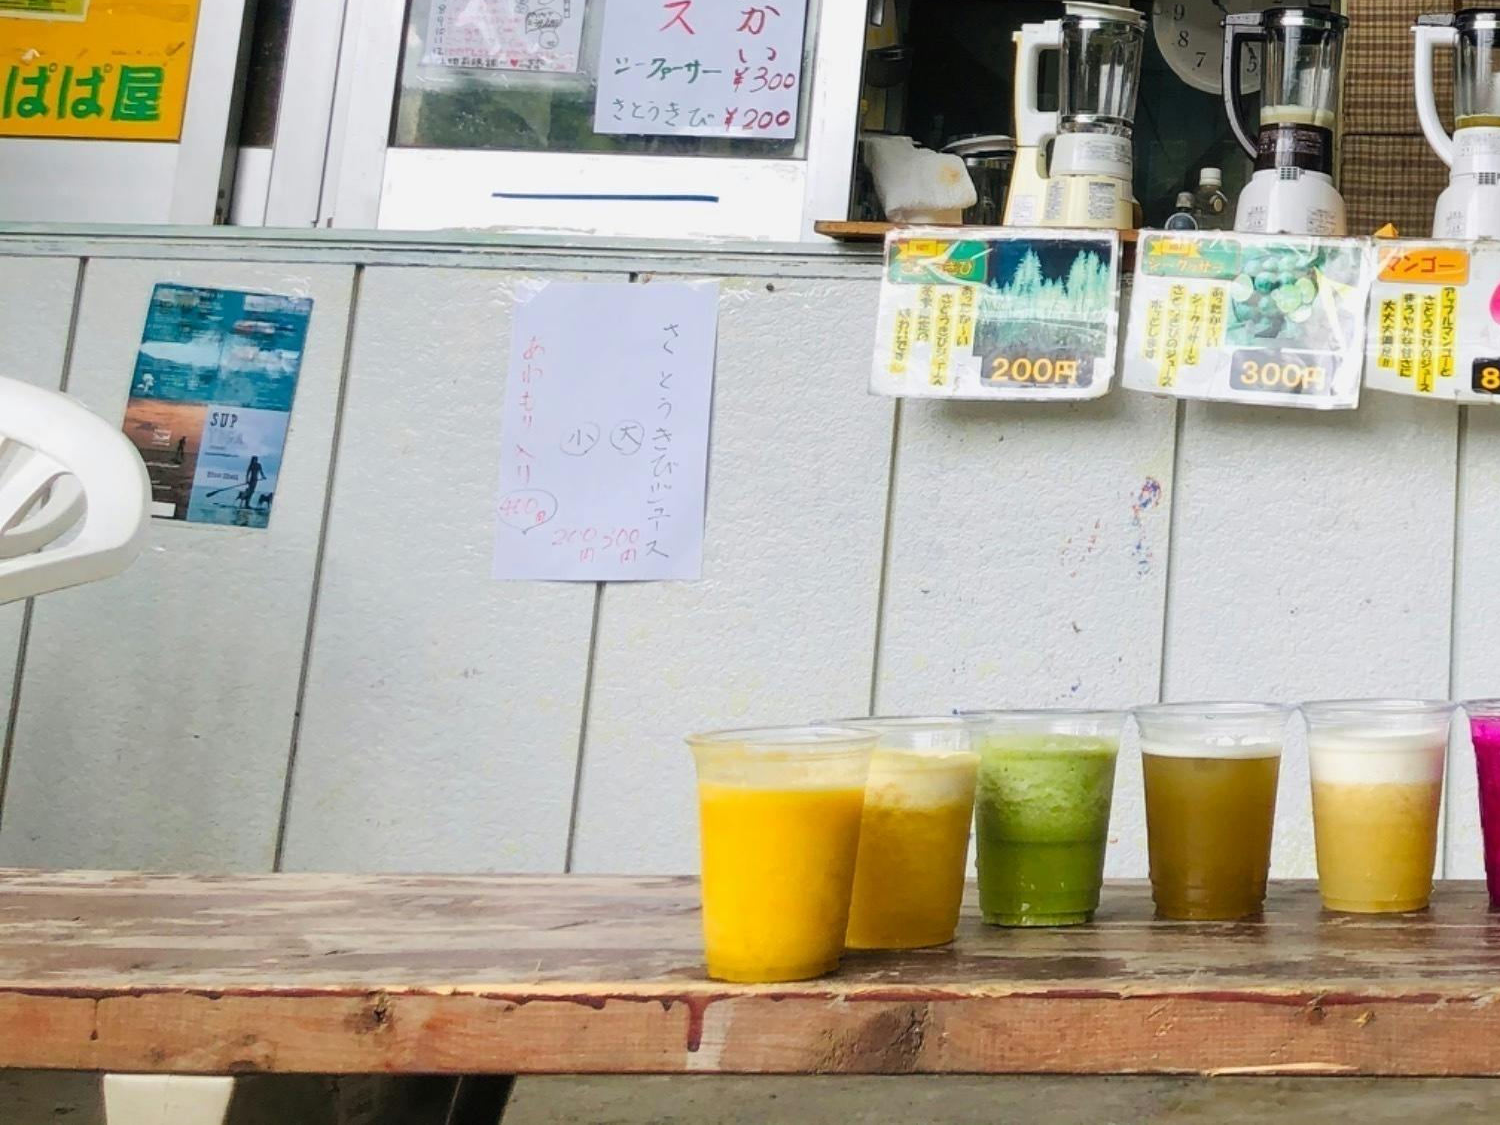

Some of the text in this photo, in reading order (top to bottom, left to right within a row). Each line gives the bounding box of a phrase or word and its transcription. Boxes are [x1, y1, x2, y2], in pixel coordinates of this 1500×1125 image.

[1174, 4, 1185, 20] 9
[1178, 31, 1189, 47] 8
[1195, 51, 1207, 68] 7
[3, 61, 164, 122] ぱぱ屋
[612, 97, 715, 127] さとうきび
[1387, 255, 1455, 273] マンゴー
[991, 357, 1078, 384] 200円
[1241, 361, 1326, 390] 300円
[209, 411, 238, 429] SUP
